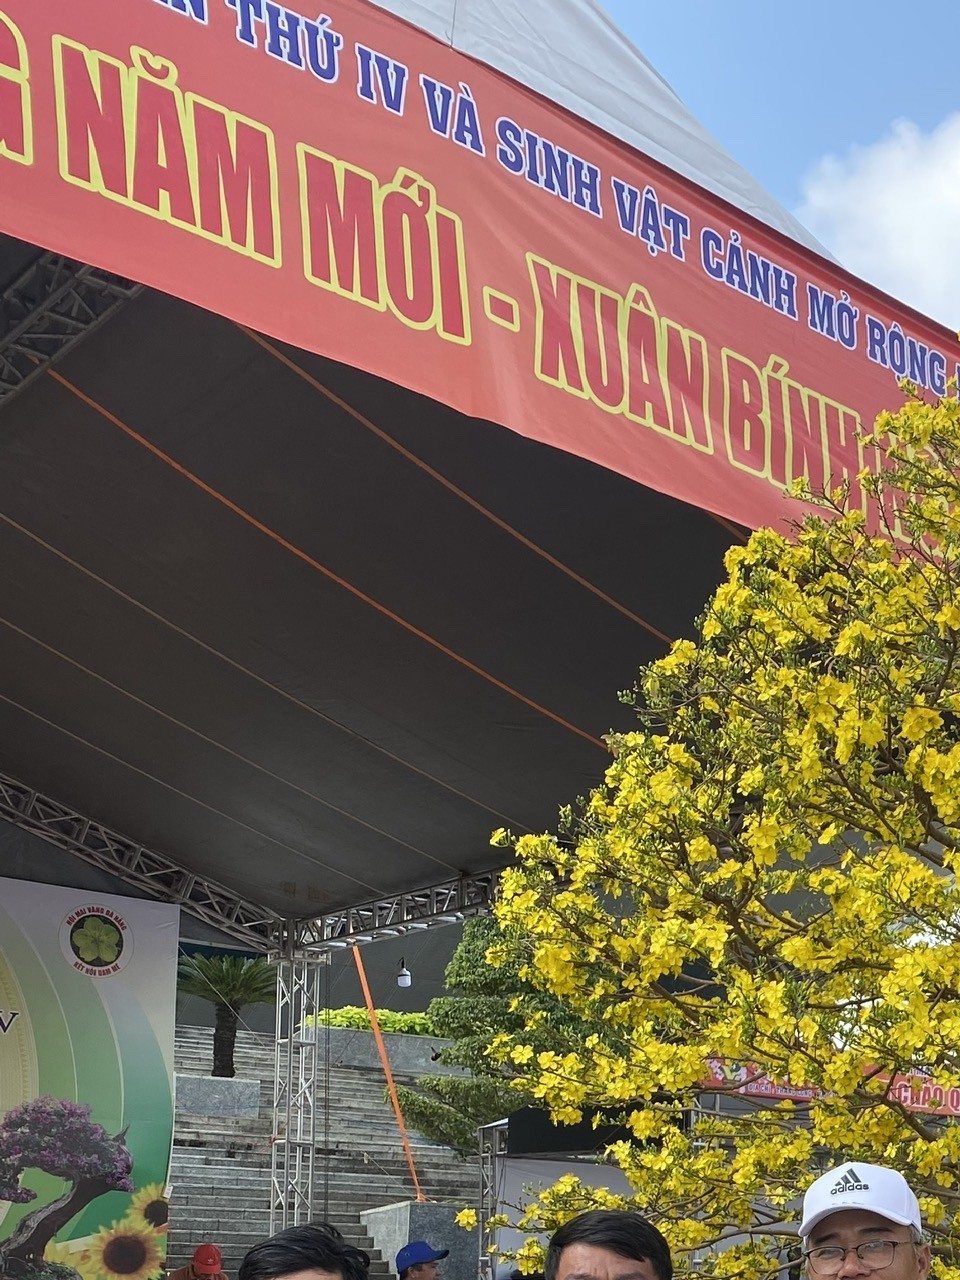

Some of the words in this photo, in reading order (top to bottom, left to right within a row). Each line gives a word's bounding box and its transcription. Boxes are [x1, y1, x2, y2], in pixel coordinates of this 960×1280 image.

[52, 33, 283, 269] NĂM
[296, 142, 472, 346] MỚI
[526, 252, 714, 456] XUÂN
[721, 347, 870, 530] BÍNH
[225, 0, 344, 83] THỨ
[355, 43, 408, 116] IV
[418, 73, 486, 157] VÀ
[496, 117, 603, 219] SINH
[611, 175, 690, 262] VẬT
[700, 226, 798, 322] CẢNH
[806, 283, 858, 351] MỞ
[867, 316, 947, 397] RỘNG
[75, 908, 87, 917] MAI
[87, 906, 104, 914] VÀNG
[830, 1183, 869, 1195] adidas
